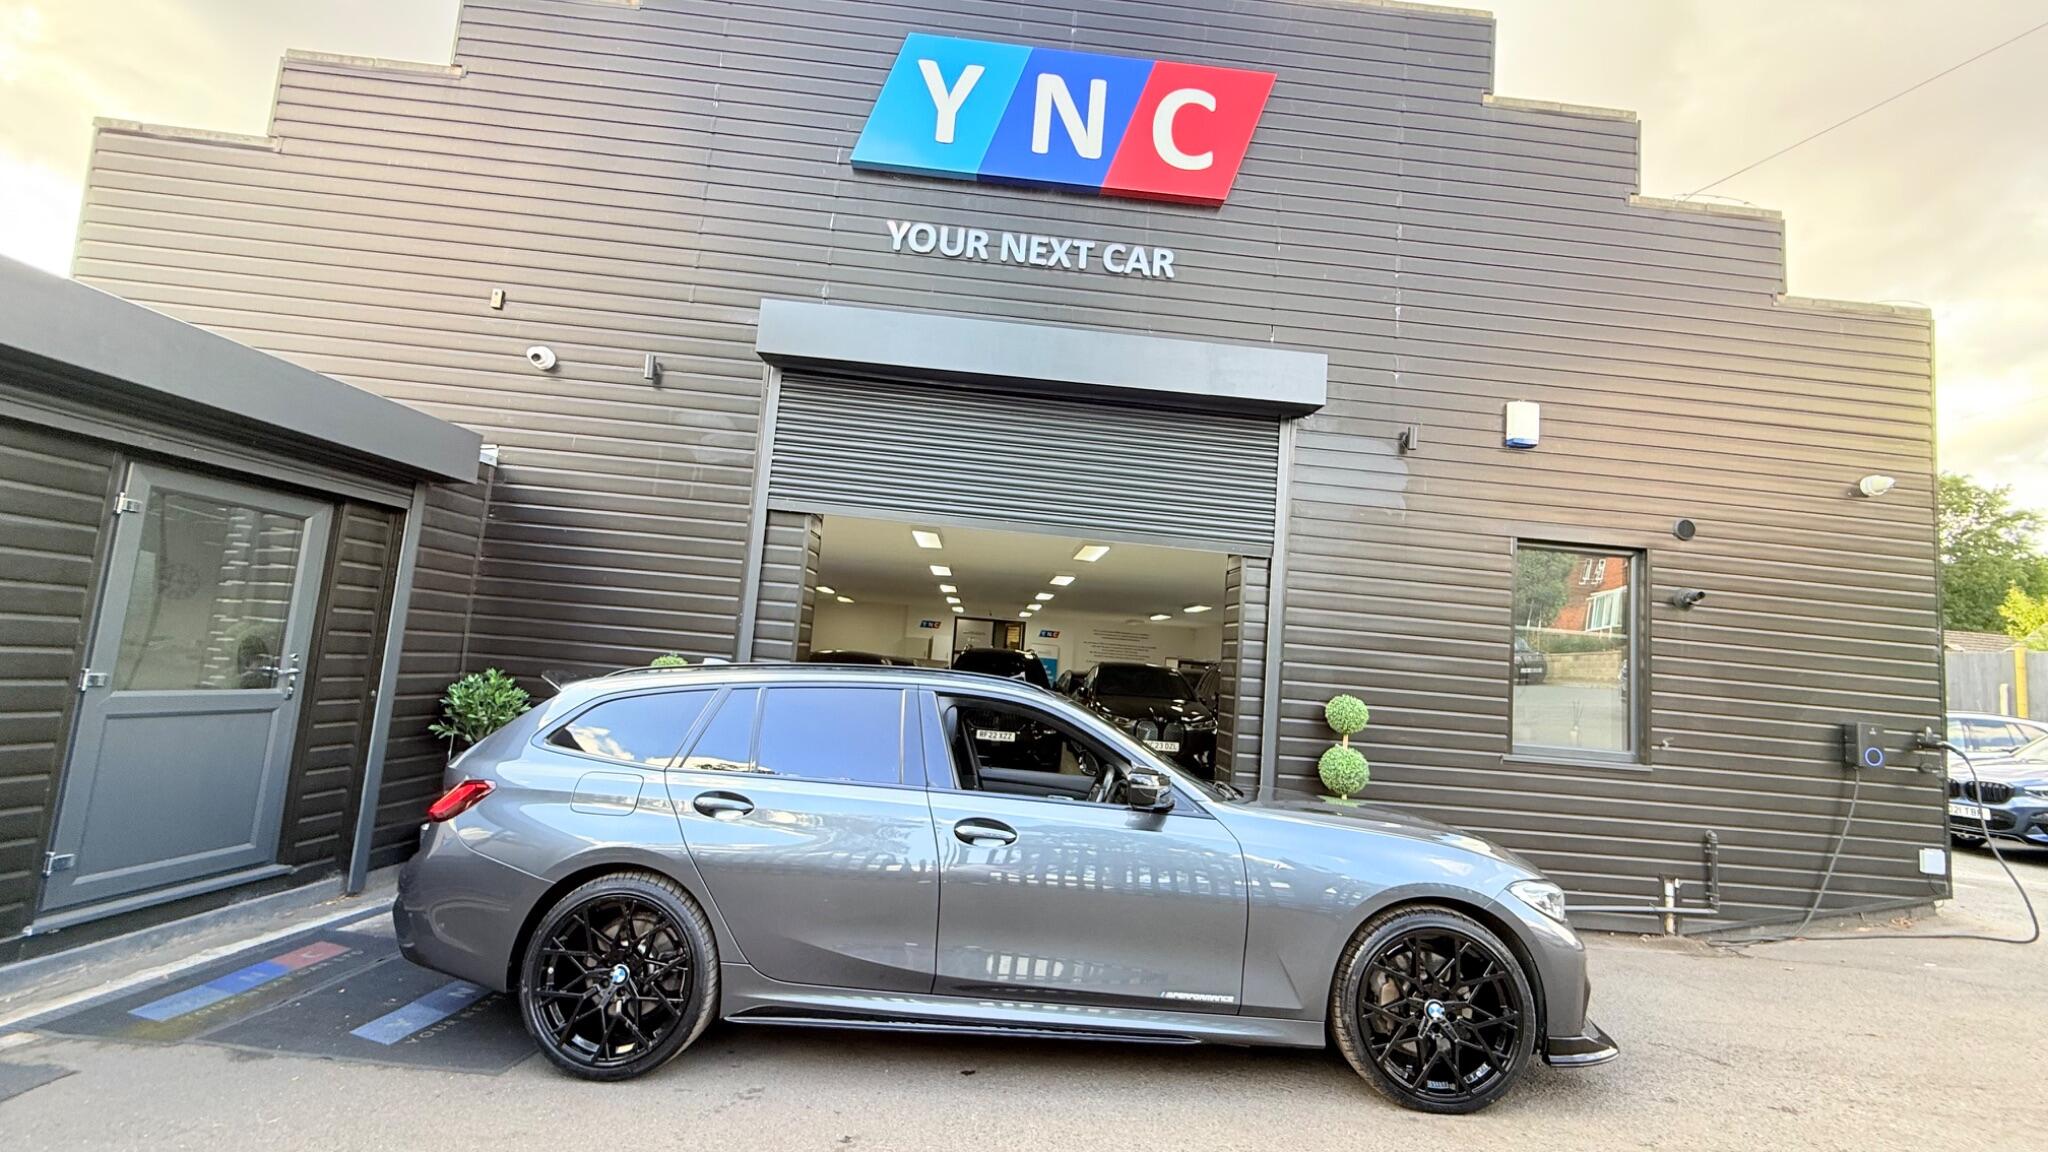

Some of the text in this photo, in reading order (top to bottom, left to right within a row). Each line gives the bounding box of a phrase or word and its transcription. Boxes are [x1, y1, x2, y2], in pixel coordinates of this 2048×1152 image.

[917, 58, 1217, 171] YNC
[886, 220, 1176, 279] YOUR NEXT CAR
